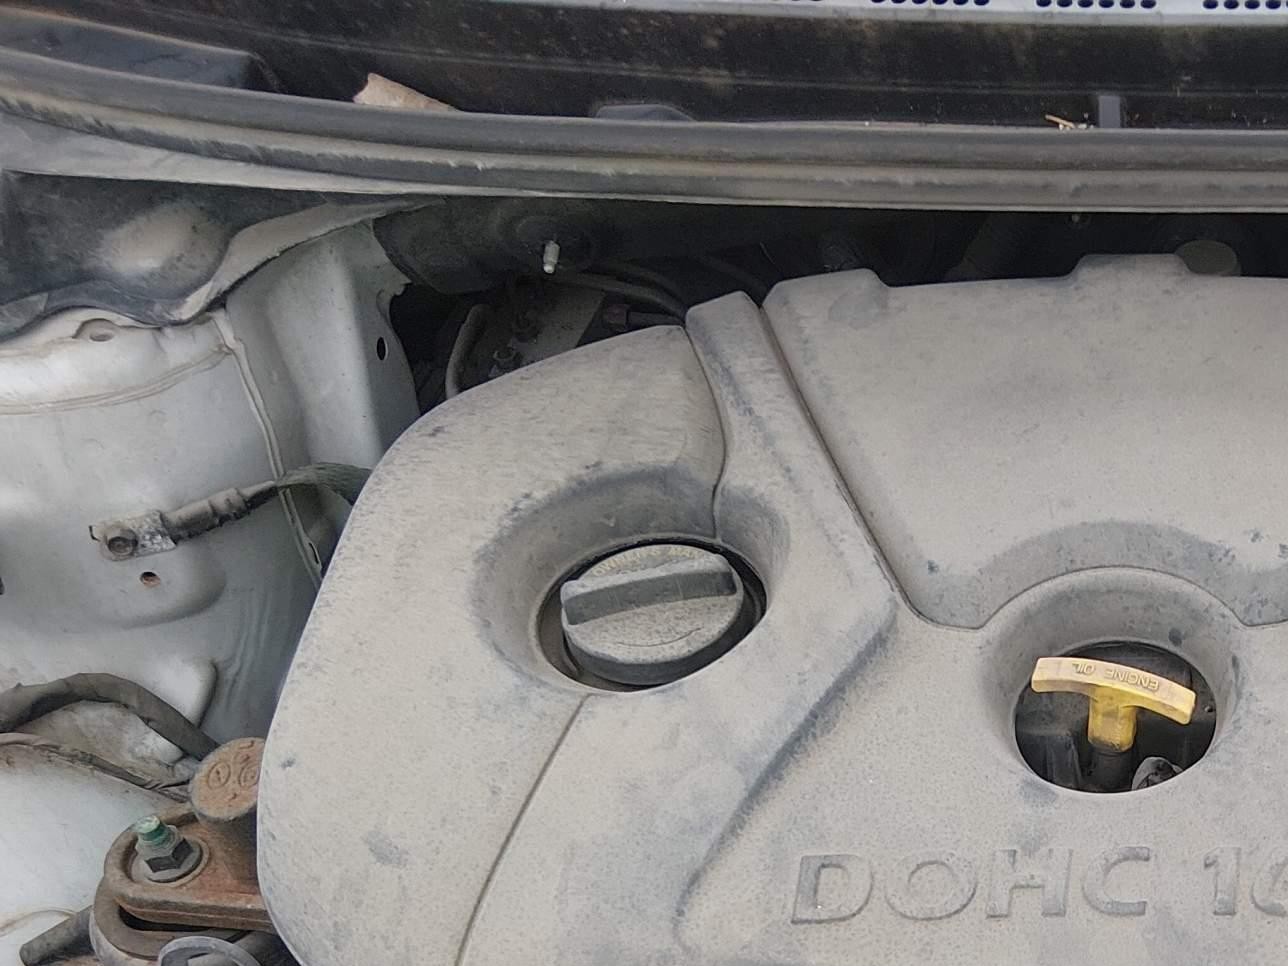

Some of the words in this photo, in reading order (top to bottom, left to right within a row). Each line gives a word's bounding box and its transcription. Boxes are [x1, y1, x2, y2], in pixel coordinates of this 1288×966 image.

[1072, 661, 1096, 676] OIL
[1104, 667, 1160, 691] ENGINE
[790, 846, 1152, 925] DOHC
